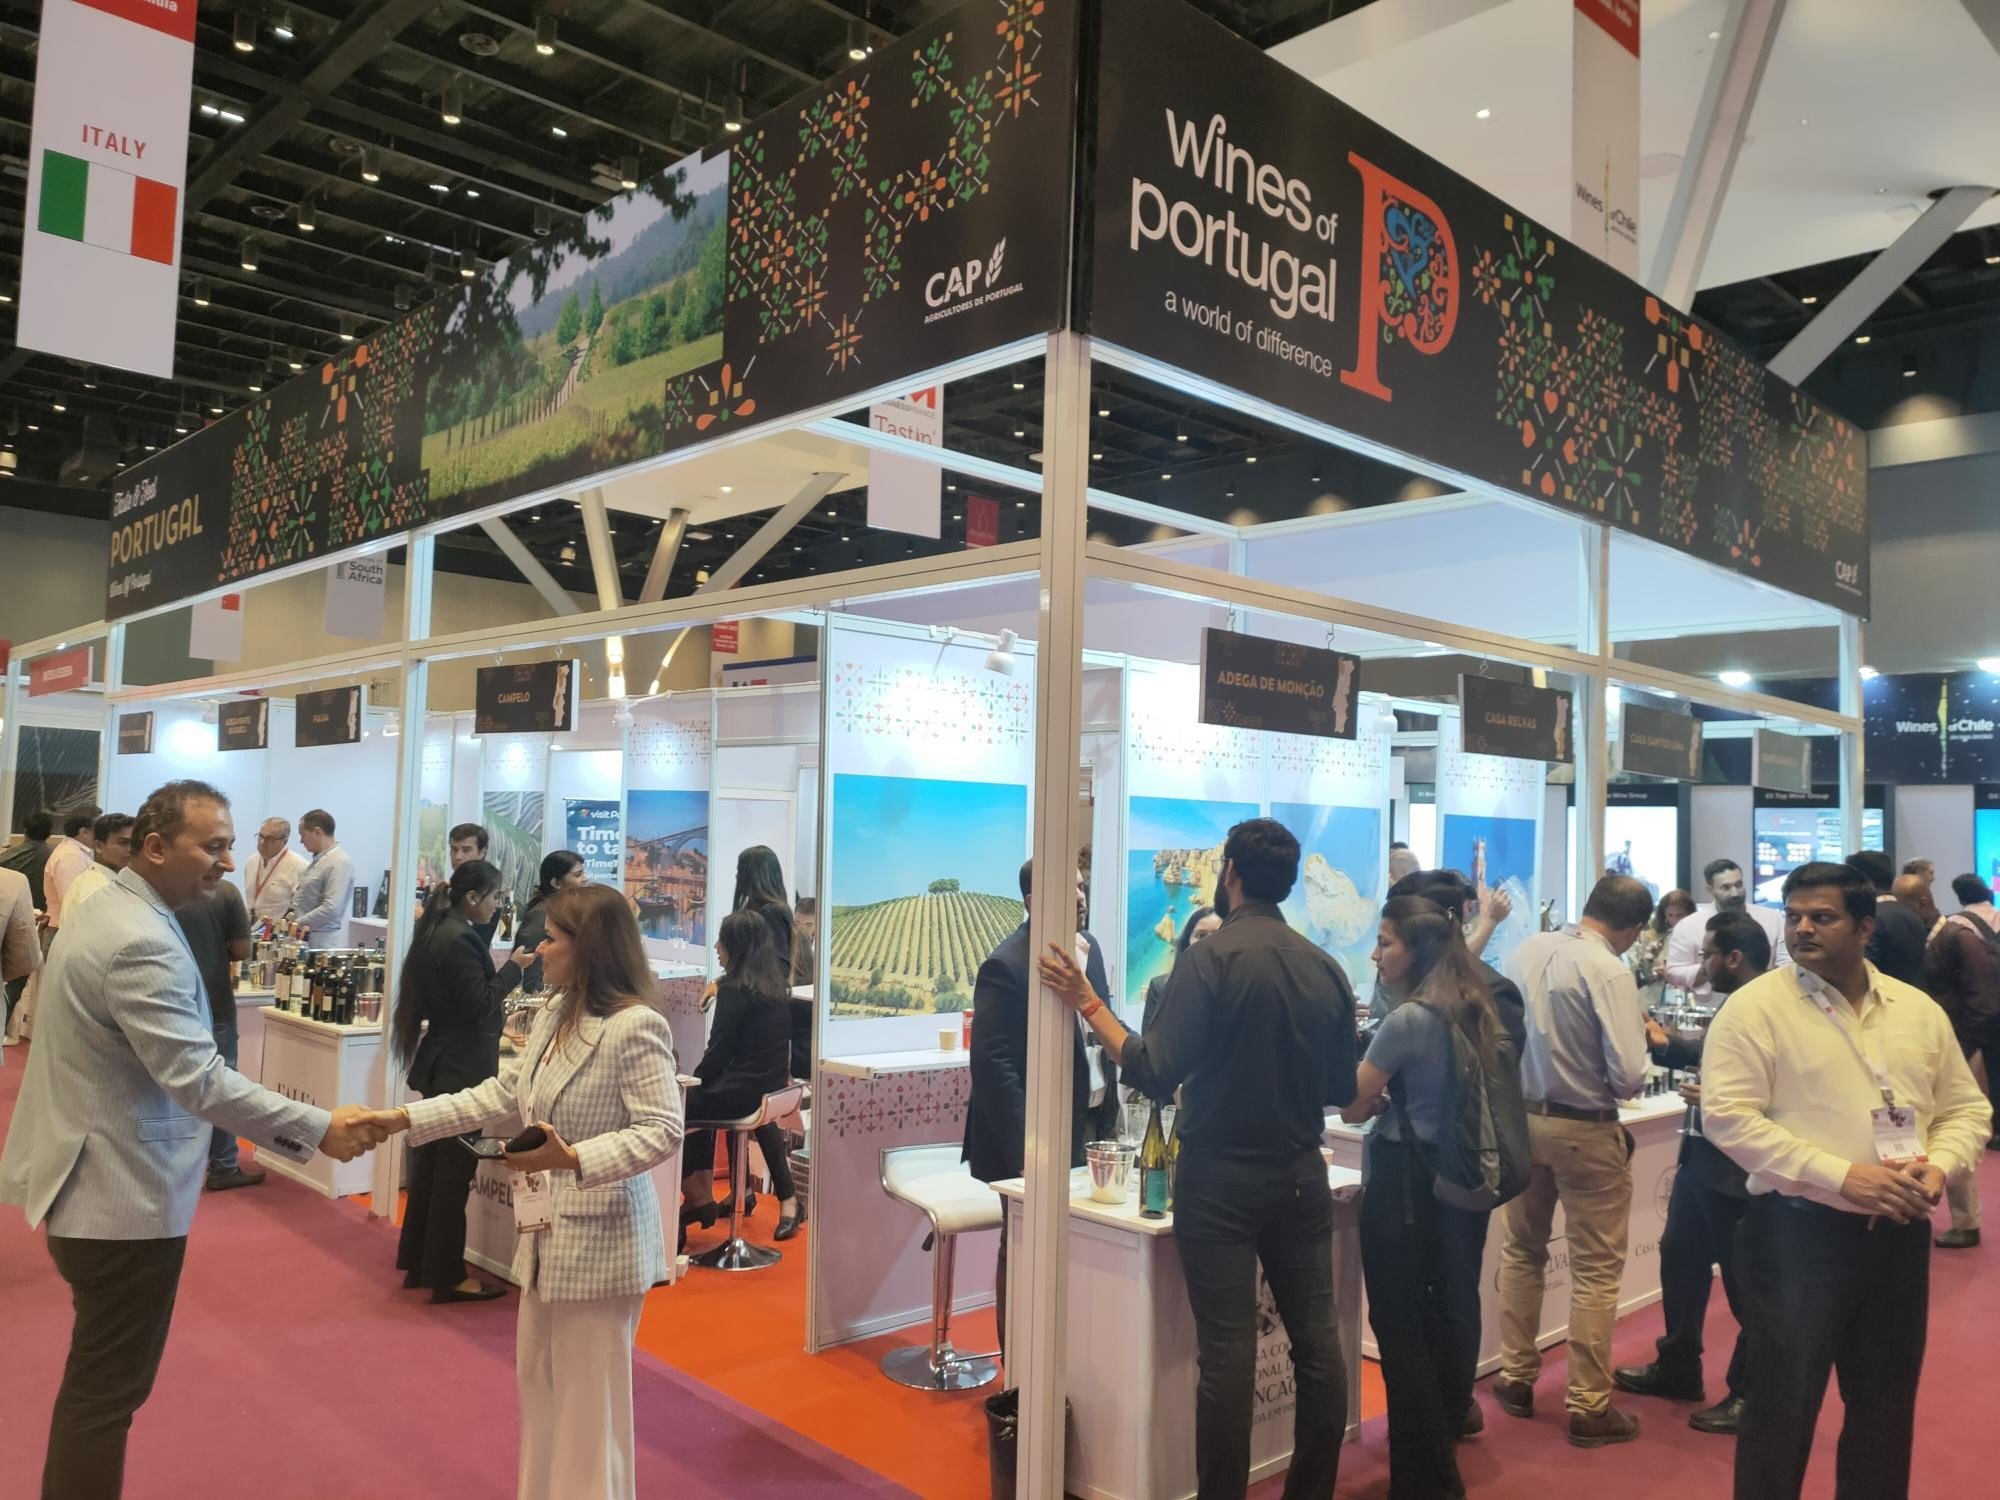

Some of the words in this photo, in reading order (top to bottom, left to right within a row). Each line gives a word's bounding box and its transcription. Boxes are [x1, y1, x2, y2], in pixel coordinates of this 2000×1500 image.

[82, 123, 147, 160] ITALY
[1165, 108, 1312, 232] Wines
[1316, 212, 1339, 245] of
[1575, 181, 1604, 213] Wines
[1130, 177, 1337, 322] portugal
[924, 259, 982, 308] CAP
[924, 300, 974, 325] AGRICULTORES
[974, 295, 985, 307] DE
[985, 282, 1025, 303] PORTUGAL
[1164, 290, 1178, 312] a
[1182, 296, 1231, 335] world
[1235, 319, 1253, 344] of
[1256, 327, 1333, 377] difference
[110, 493, 203, 568] PORTUGAL
[348, 571, 383, 585] Africa
[349, 560, 383, 575] South
[497, 691, 530, 704] CAMPELO
[1217, 670, 1257, 689] ADEGA
[1259, 676, 1275, 692] DE
[1276, 678, 1325, 699] MONÇÃO
[1485, 711, 1505, 725] CASA
[1895, 721, 1938, 733] Wines
[1958, 719, 1994, 732] Chile
[590, 809, 610, 818] visit
[577, 841, 599, 855] to
